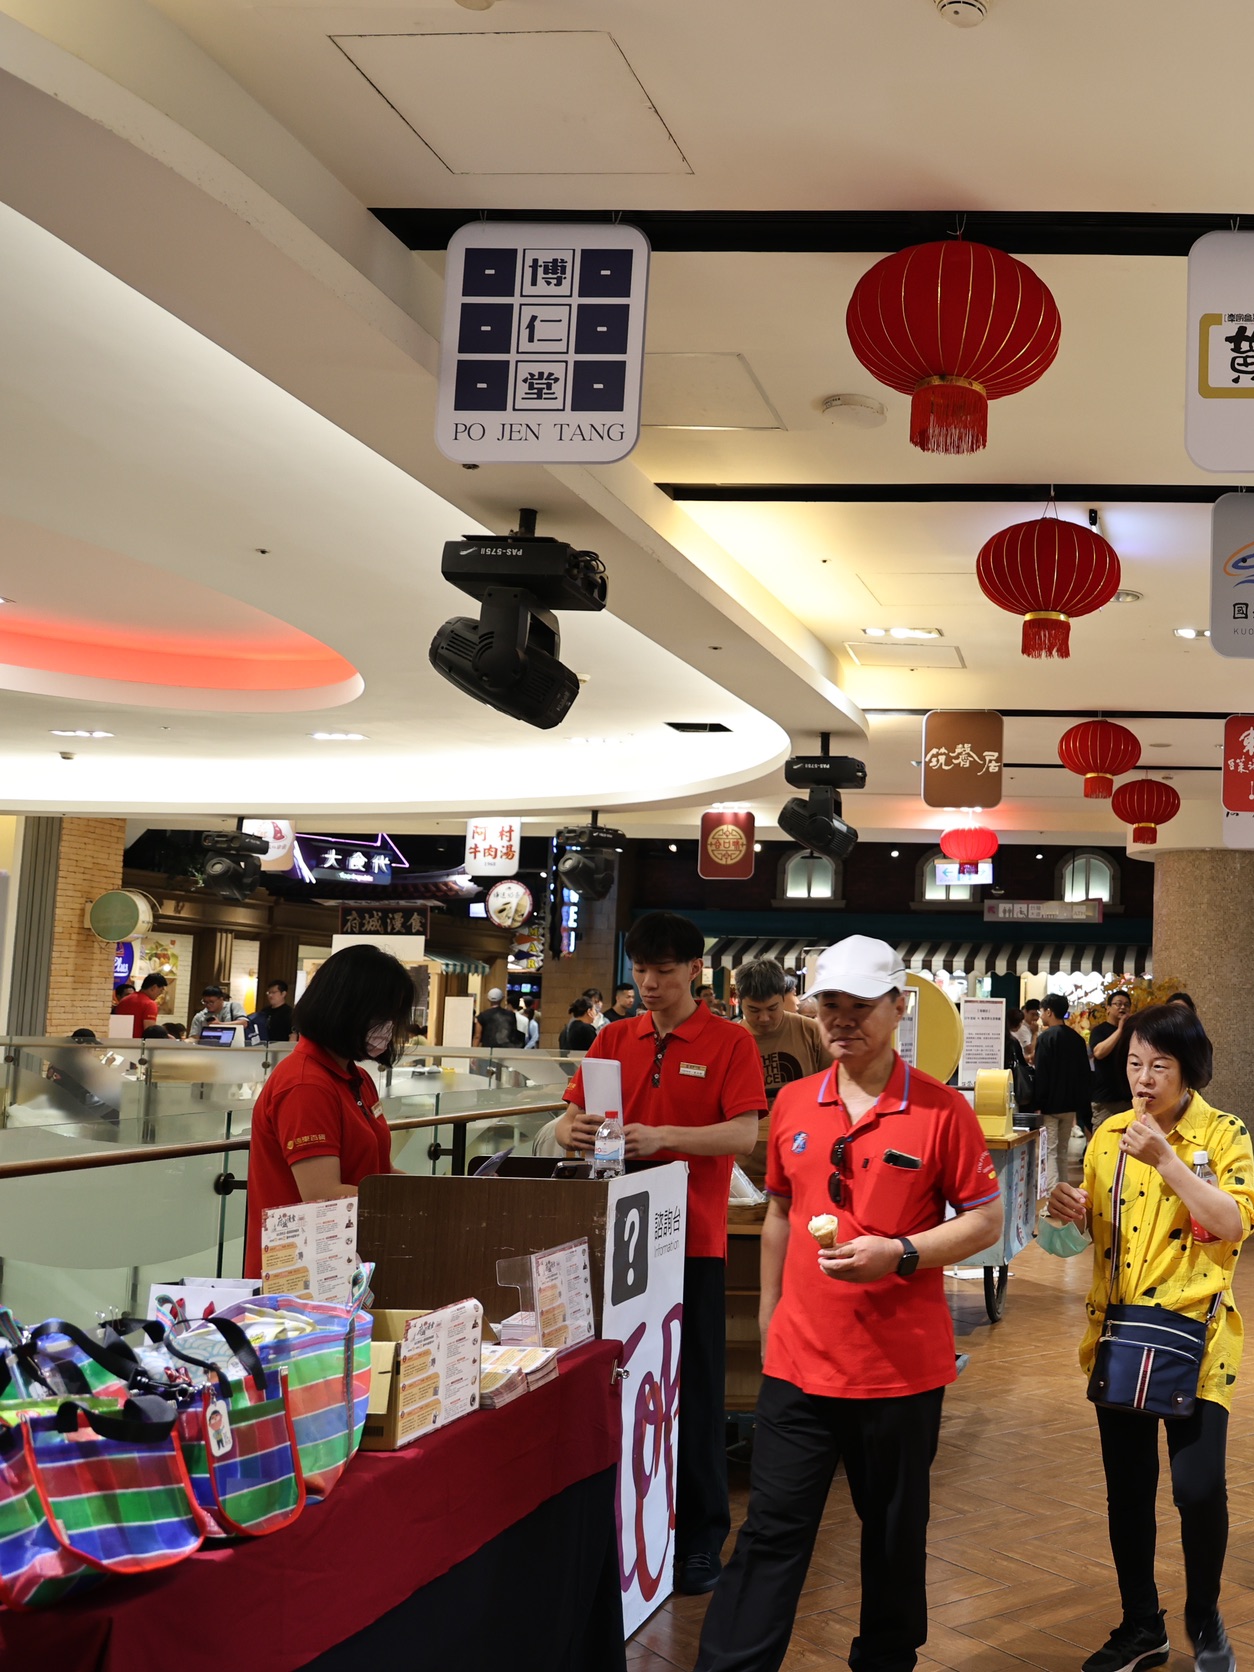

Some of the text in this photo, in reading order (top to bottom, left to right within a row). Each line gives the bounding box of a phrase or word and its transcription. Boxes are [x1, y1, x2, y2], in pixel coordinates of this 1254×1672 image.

[520, 256, 569, 402] 博仁堂
[452, 422, 626, 443] PO JEN TANG
[320, 849, 390, 873] 大食代
[468, 844, 516, 861] 牛肉湯
[766, 1074, 780, 1085] CE
[654, 1205, 681, 1240] 諮詢台
